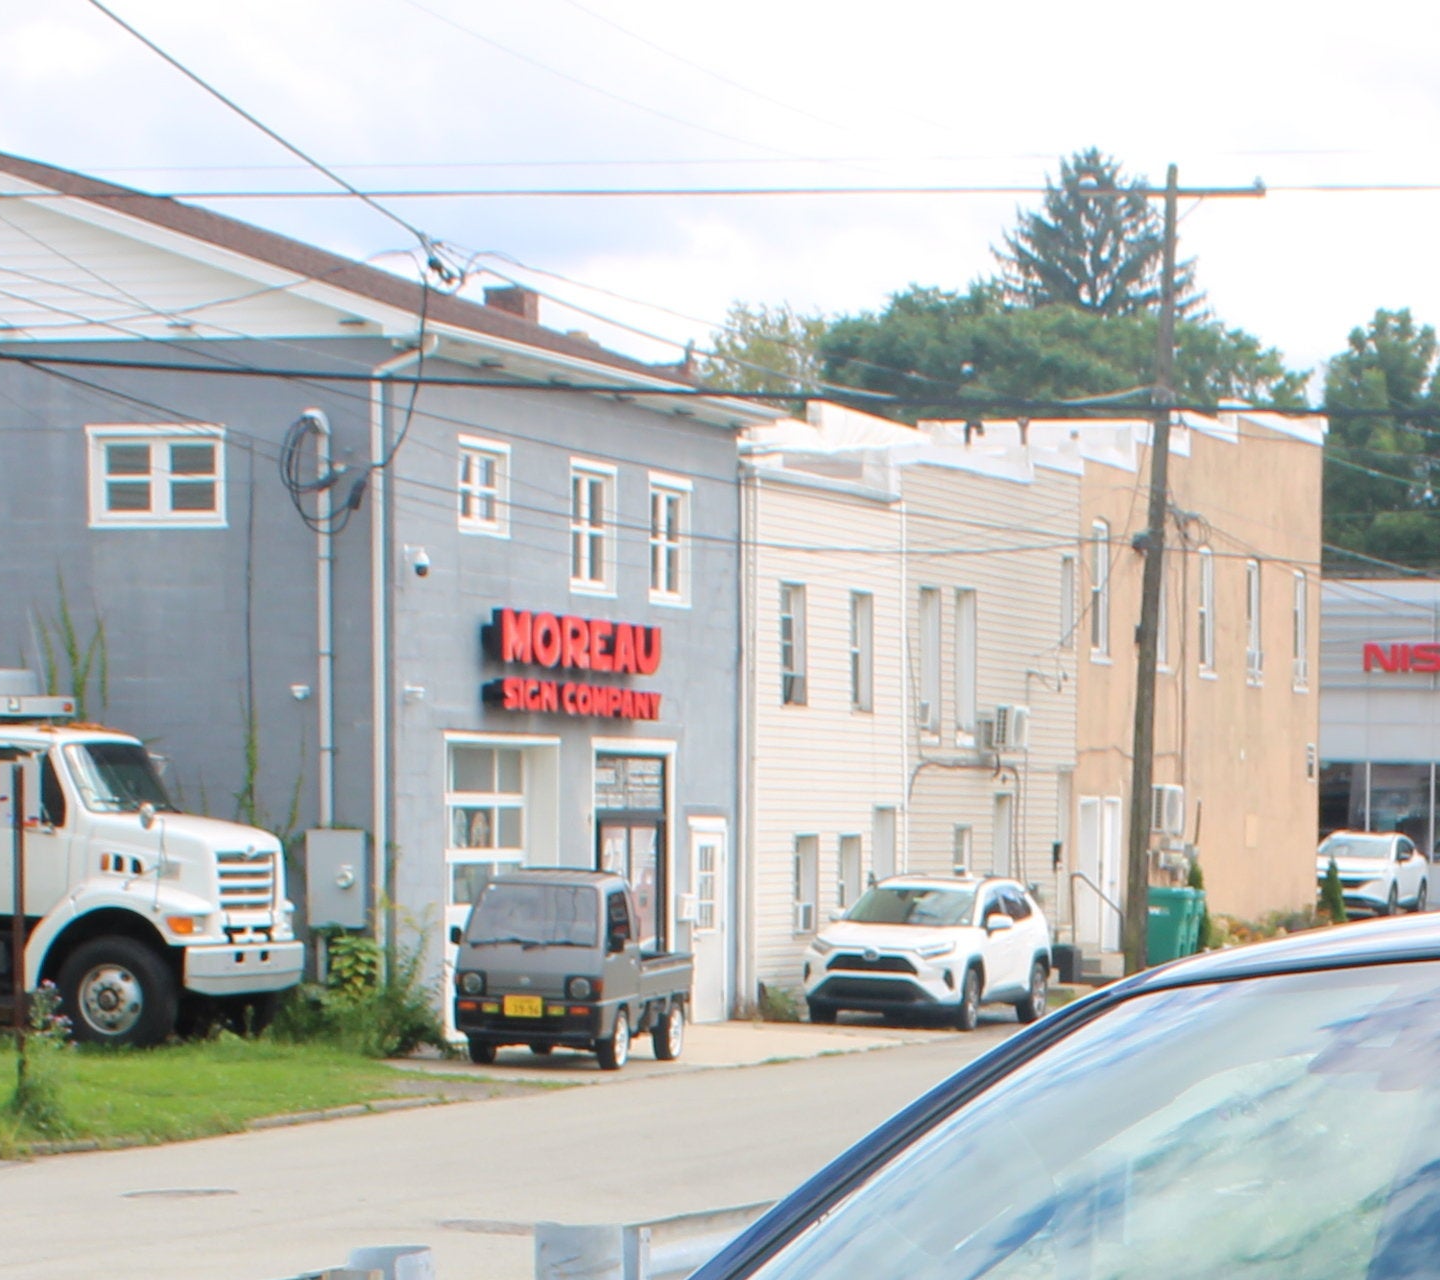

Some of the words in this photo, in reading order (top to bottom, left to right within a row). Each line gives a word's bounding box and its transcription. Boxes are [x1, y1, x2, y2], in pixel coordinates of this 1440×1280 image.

[501, 608, 662, 676] MOREAU
[503, 677, 558, 712] SIGN
[562, 682, 662, 721] COMPANY
